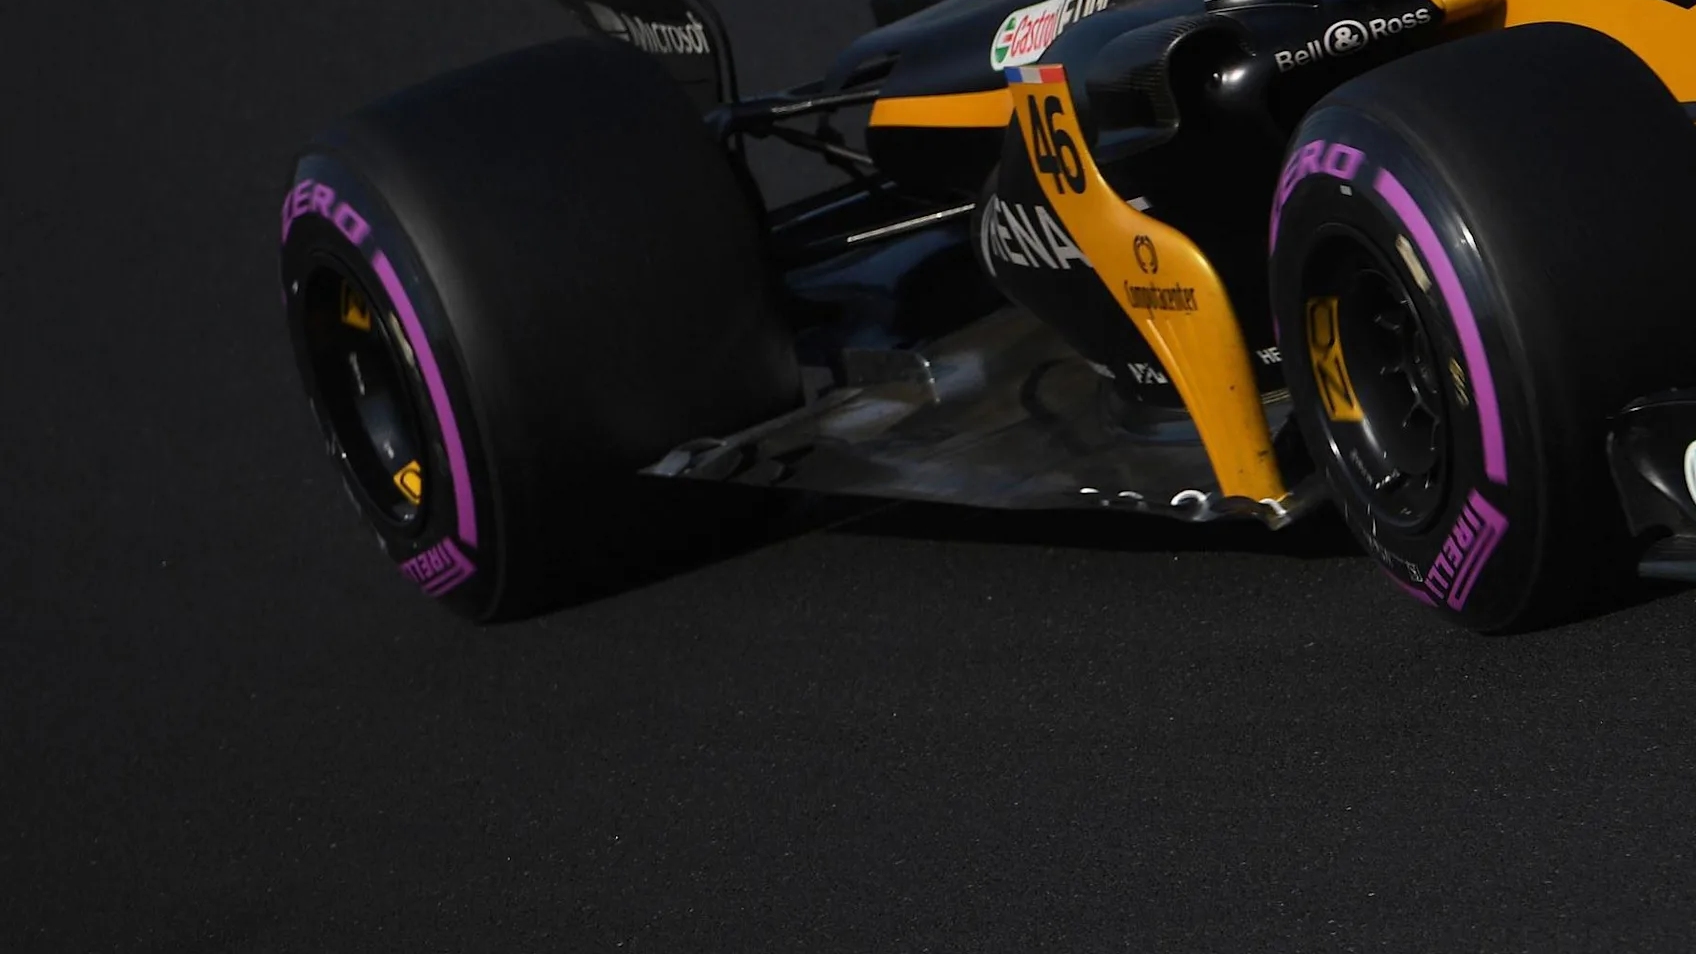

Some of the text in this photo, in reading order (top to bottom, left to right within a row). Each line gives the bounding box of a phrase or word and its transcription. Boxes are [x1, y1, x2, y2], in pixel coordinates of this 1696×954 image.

[1010, 9, 1061, 58] Castrol
[1274, 39, 1324, 73] Bell
[1369, 8, 1432, 40] Ross
[1028, 94, 1087, 195] 46
[1424, 487, 1509, 612] PIRELLI
